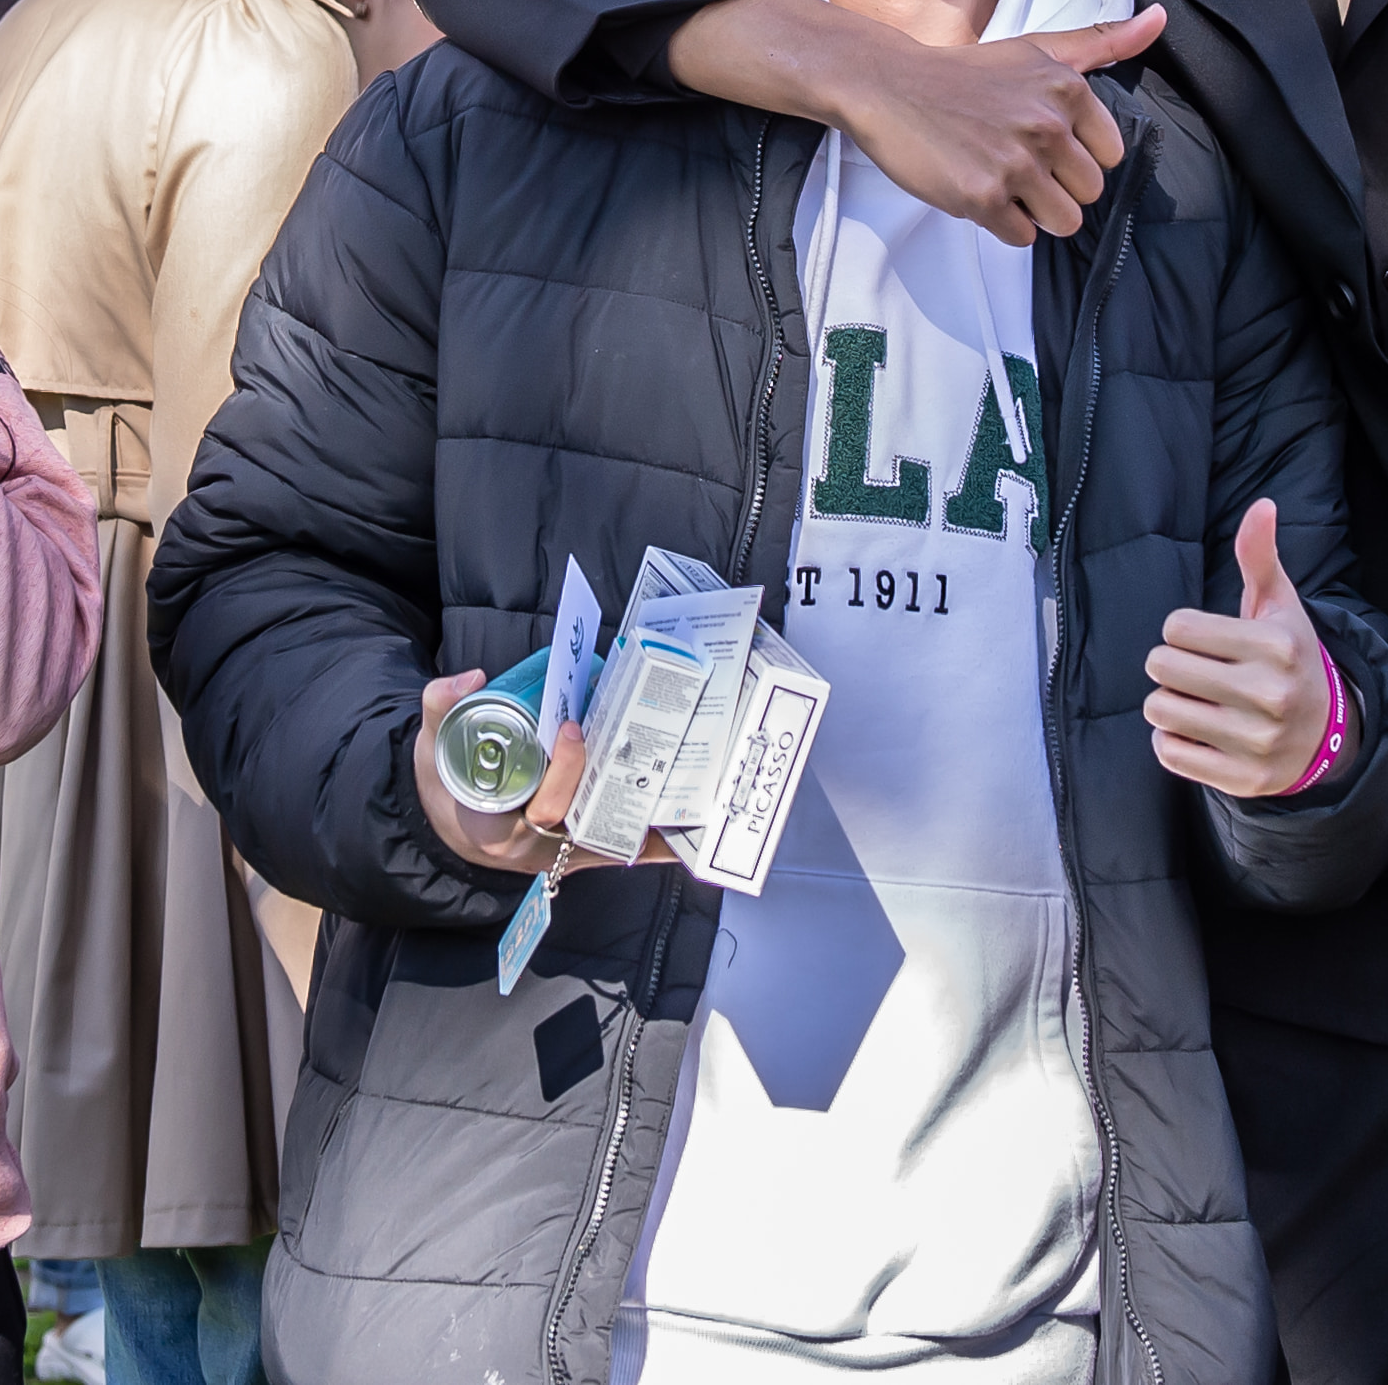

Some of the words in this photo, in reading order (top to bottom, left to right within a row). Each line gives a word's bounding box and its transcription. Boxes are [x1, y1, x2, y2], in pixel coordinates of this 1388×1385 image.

[810, 323, 1050, 560] LA
[848, 567, 949, 615] 1911
[747, 730, 795, 835] PICASSO
